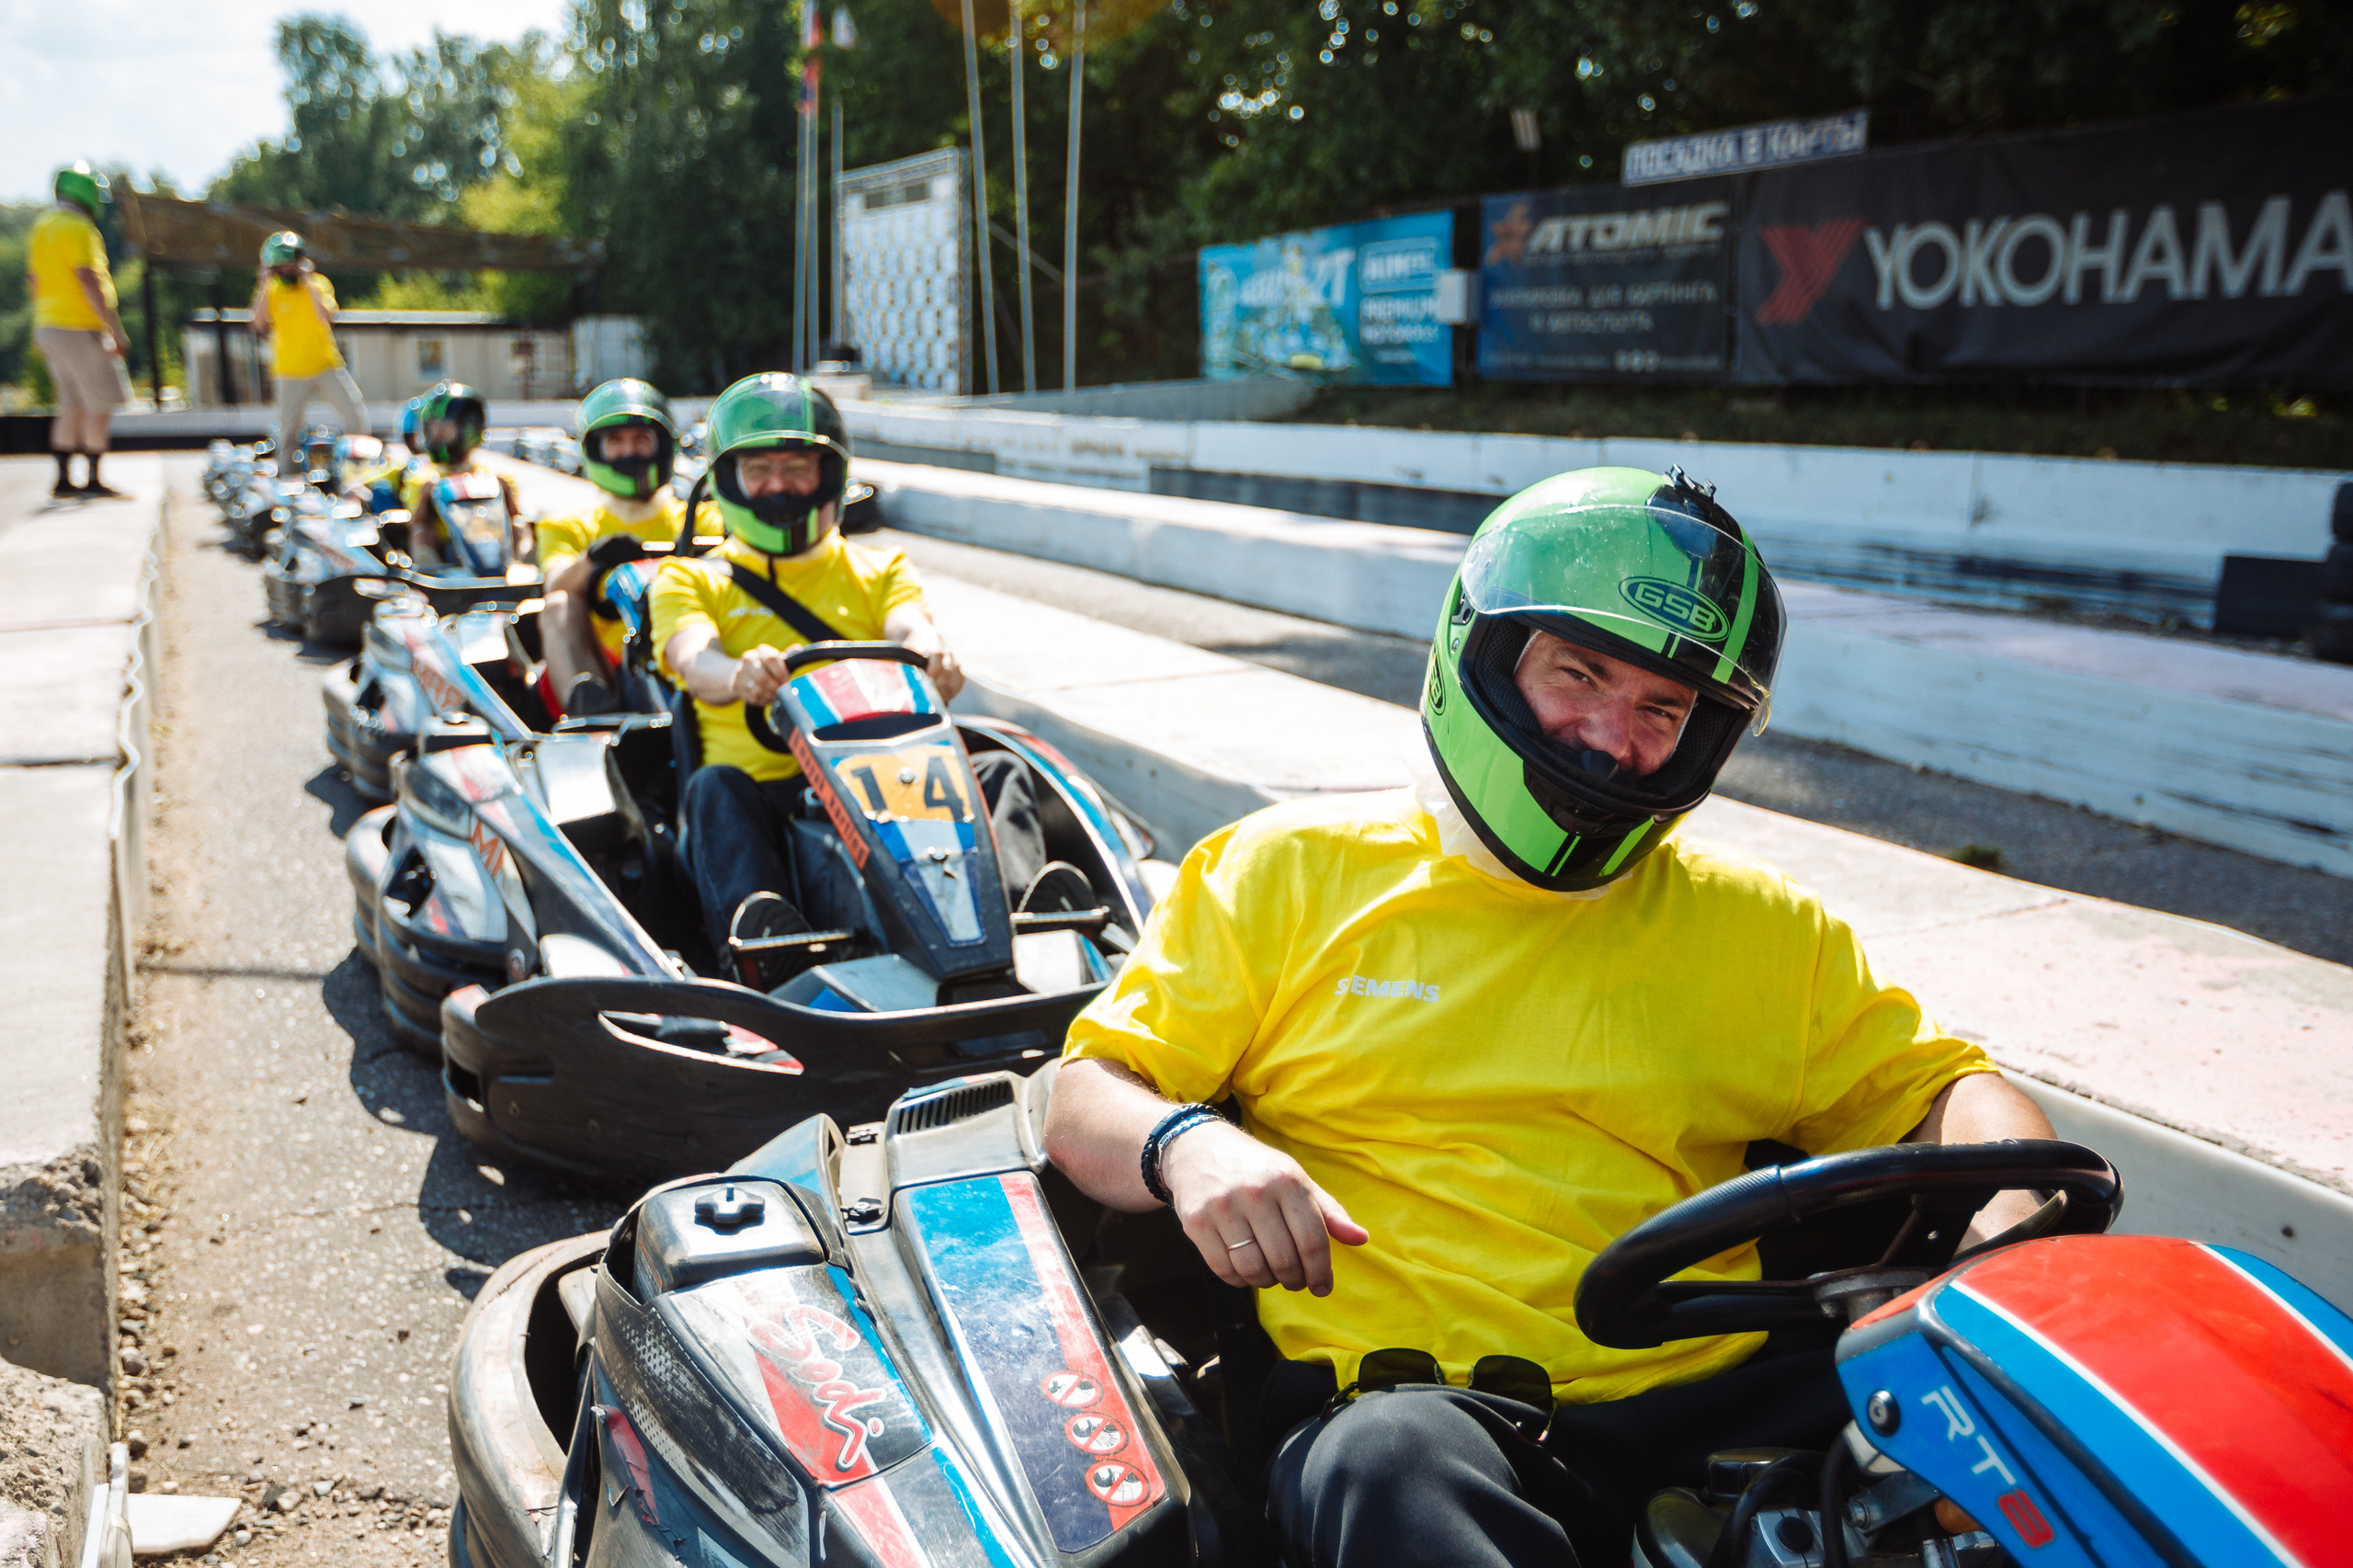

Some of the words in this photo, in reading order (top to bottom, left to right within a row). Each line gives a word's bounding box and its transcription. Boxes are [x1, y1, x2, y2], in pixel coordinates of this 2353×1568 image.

[1526, 201, 1727, 254] ATOMIC
[1864, 189, 2353, 311] YOKOHAMA
[1634, 583, 1716, 632] GSB
[851, 756, 965, 822] 14
[1335, 974, 1440, 1003] SEMENS
[1921, 1386, 2055, 1549] RT8
